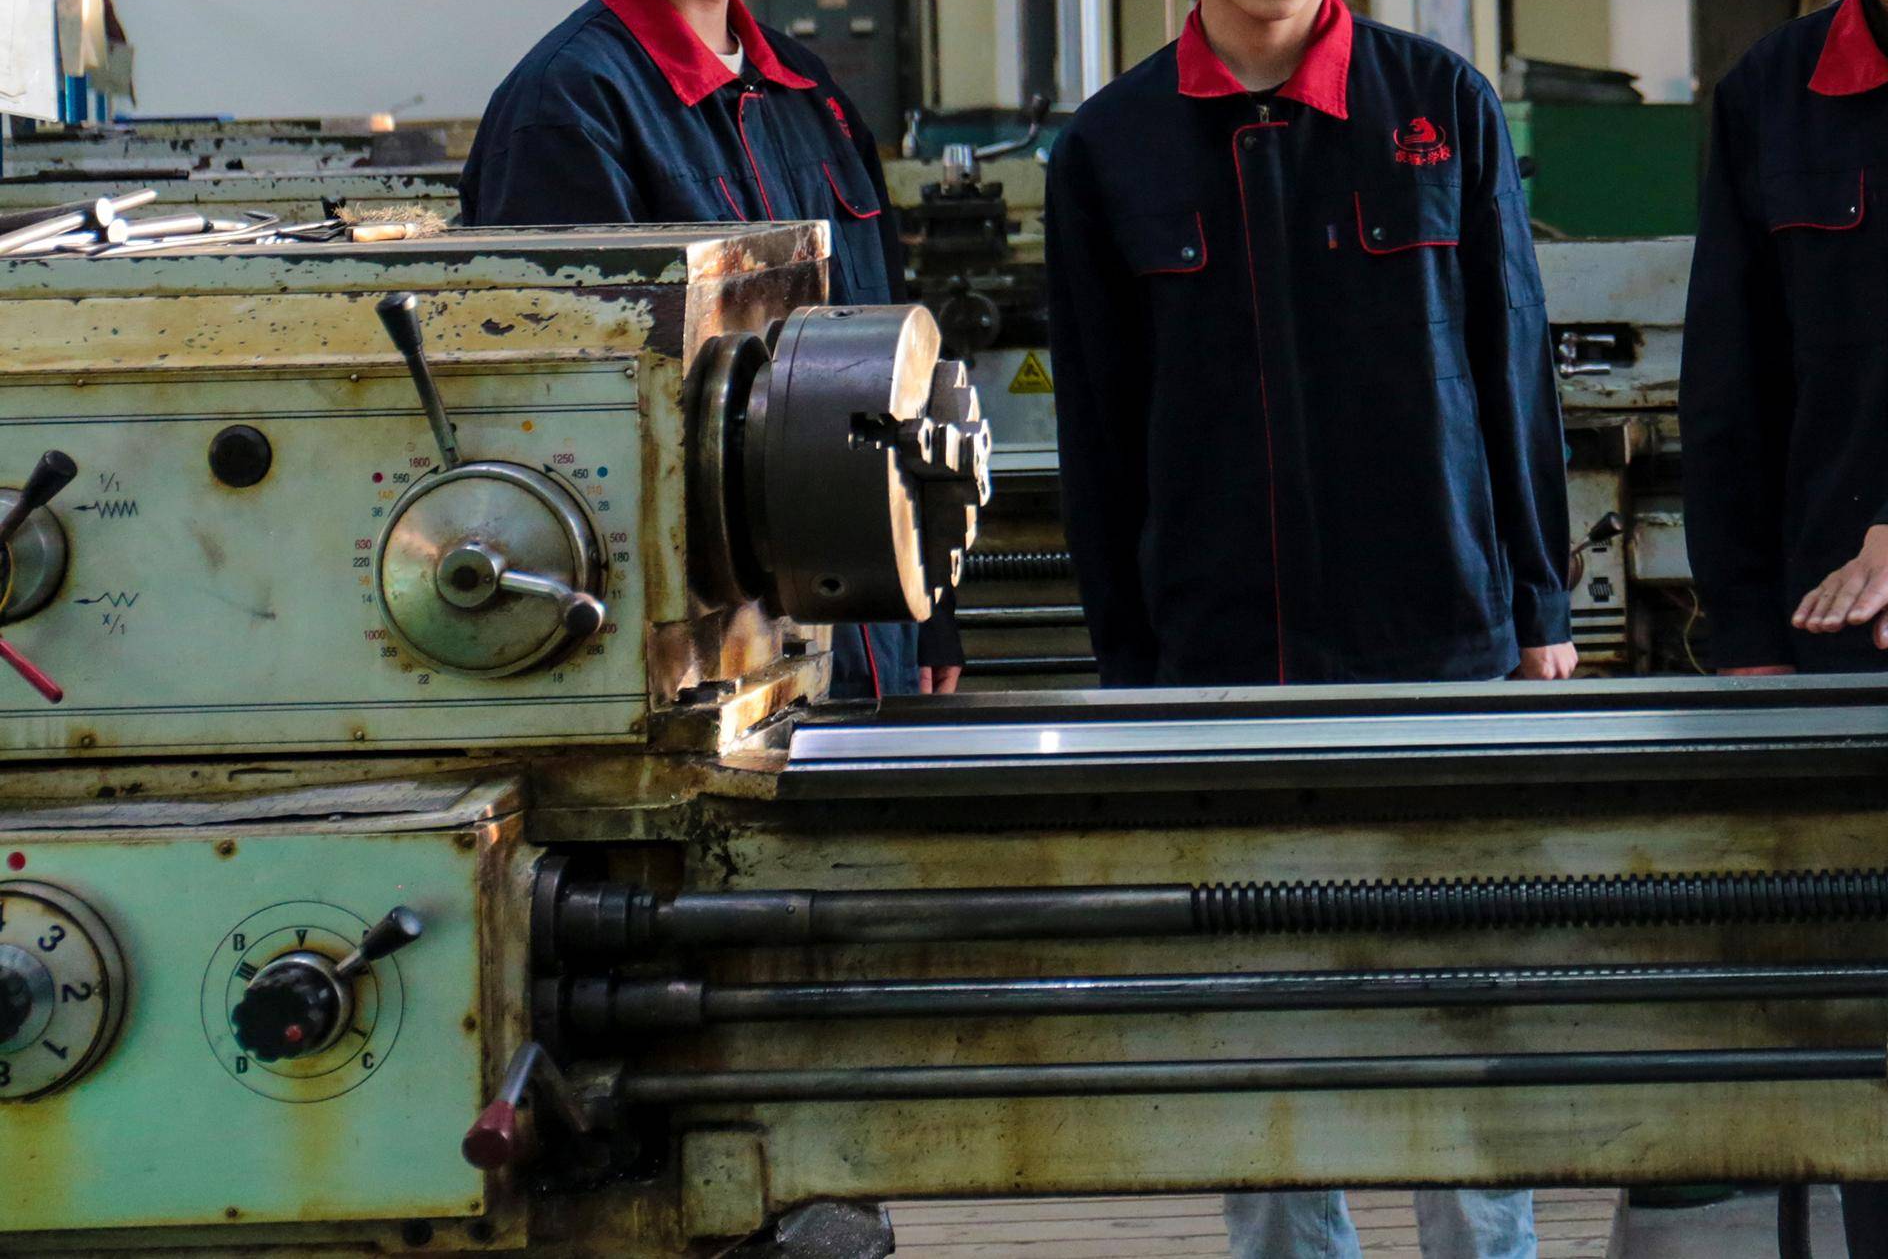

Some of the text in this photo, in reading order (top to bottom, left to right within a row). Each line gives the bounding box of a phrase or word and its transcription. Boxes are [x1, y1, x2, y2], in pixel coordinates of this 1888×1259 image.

[409, 457, 430, 468] 1600
[552, 454, 575, 464] 1250
[571, 469, 589, 479] 450
[598, 501, 610, 511] 28
[371, 507, 383, 517] 36
[609, 532, 627, 542] 500
[353, 557, 370, 567] 220
[613, 552, 629, 562] 180
[362, 595, 372, 603] 14
[364, 629, 386, 640] 1000
[380, 647, 398, 657] 355
[418, 674, 430, 684] 22
[552, 673, 563, 683] 18
[38, 925, 66, 952] 3
[233, 933, 246, 952] B
[62, 982, 92, 1003] 2
[42, 1039, 68, 1060] 1
[236, 1056, 248, 1074] D
[361, 1052, 374, 1069] C
